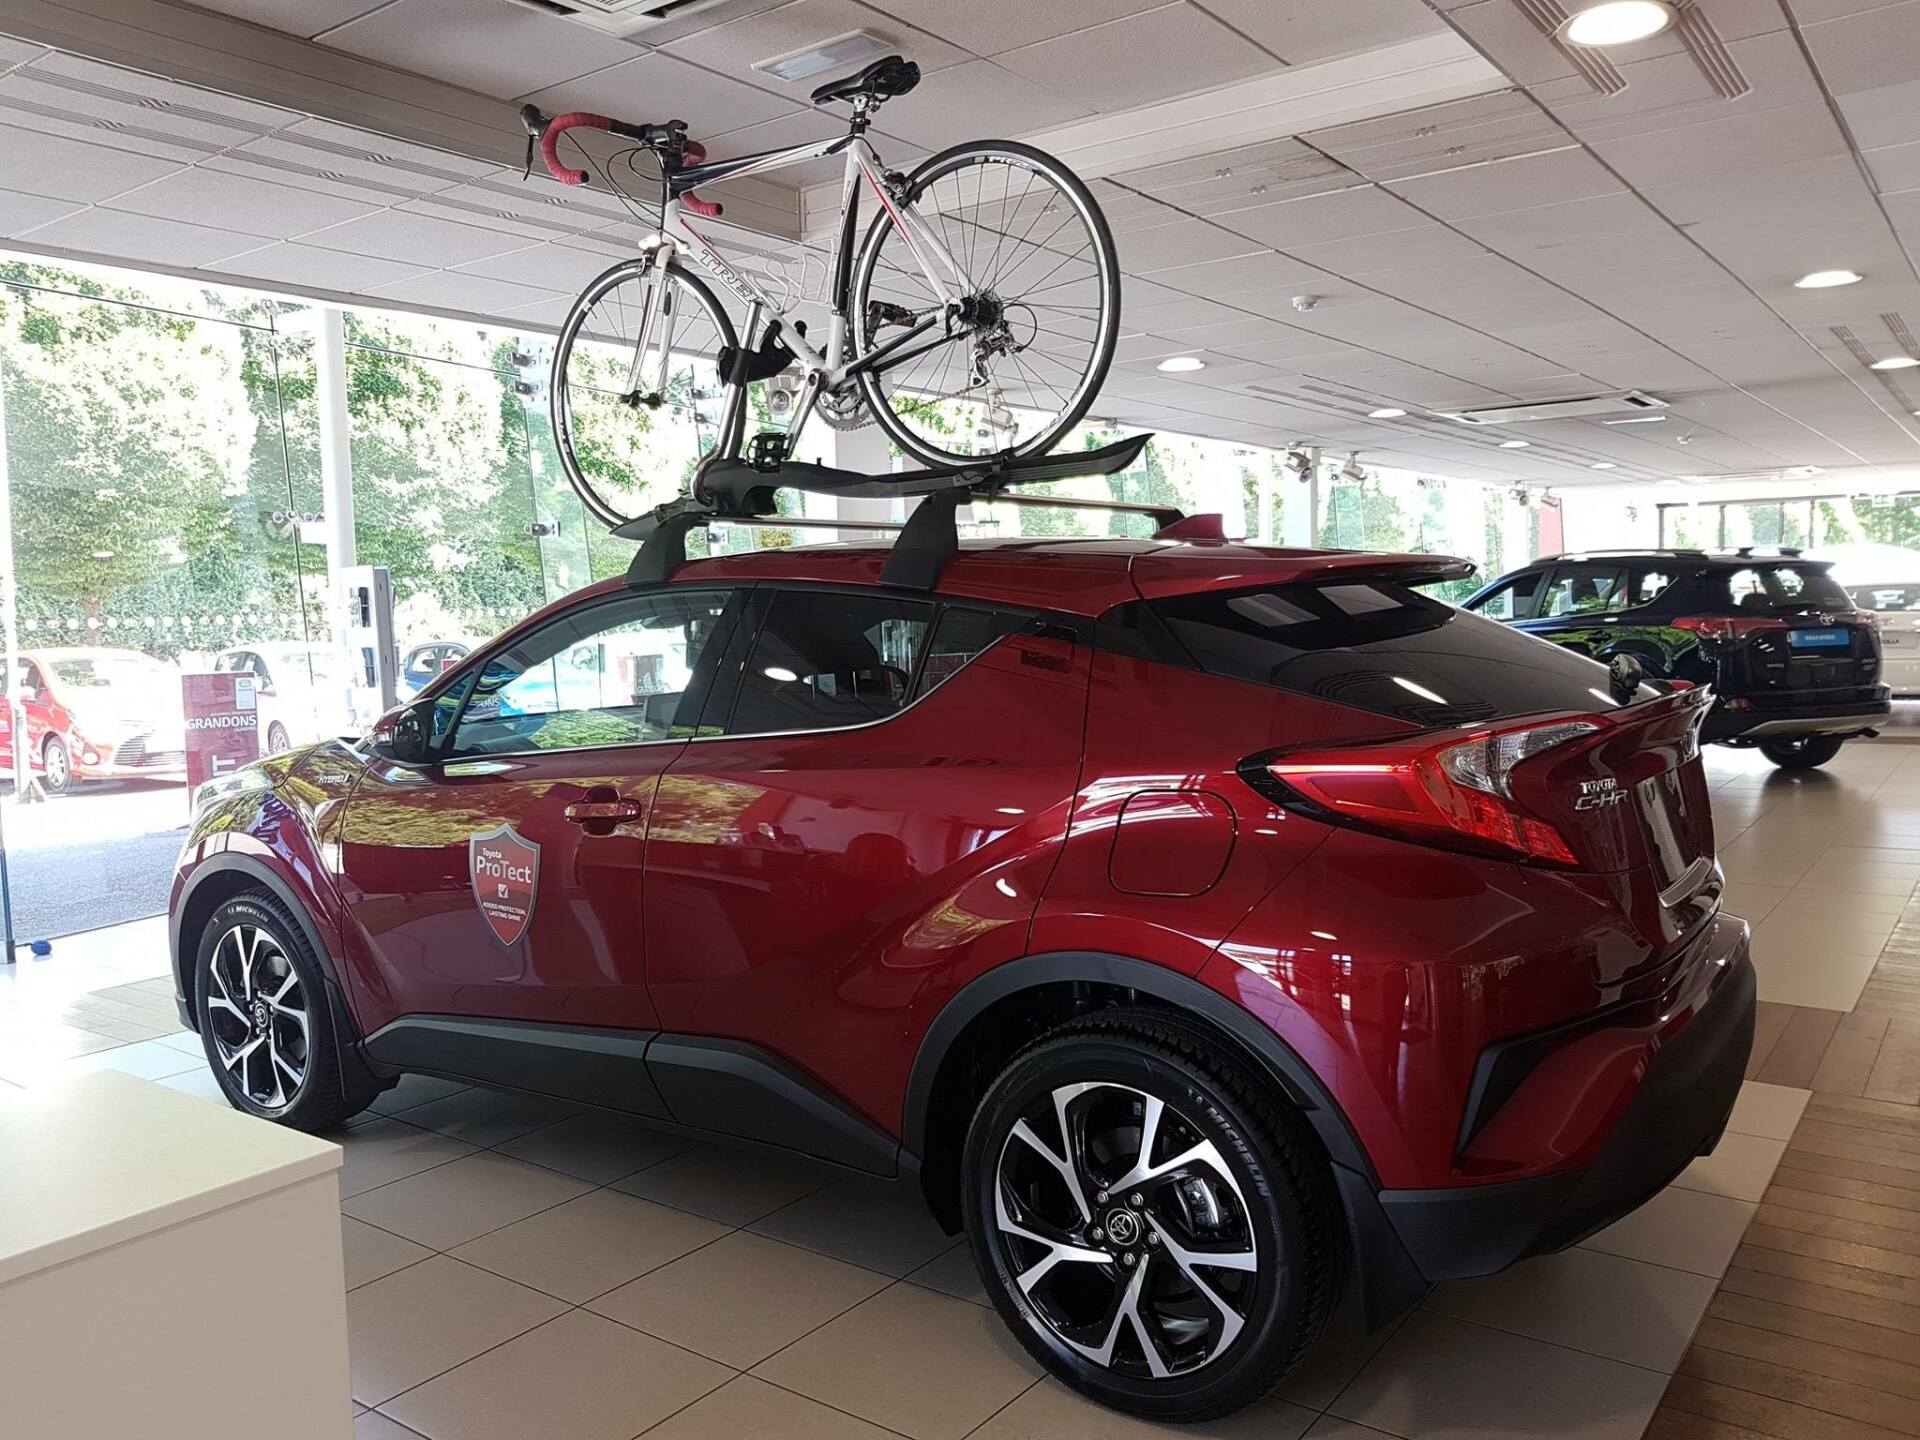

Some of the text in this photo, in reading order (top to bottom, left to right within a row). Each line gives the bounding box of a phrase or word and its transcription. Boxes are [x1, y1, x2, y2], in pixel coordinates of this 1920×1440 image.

[187, 714, 257, 729] GRANDONS
[1580, 777, 1618, 794] TOYOTA
[1574, 789, 1629, 811] C-HR
[481, 847, 502, 859] Toyota
[476, 855, 532, 884] ProTect
[235, 905, 270, 923] MICHELIN
[1207, 1106, 1272, 1198] MICHELIN
